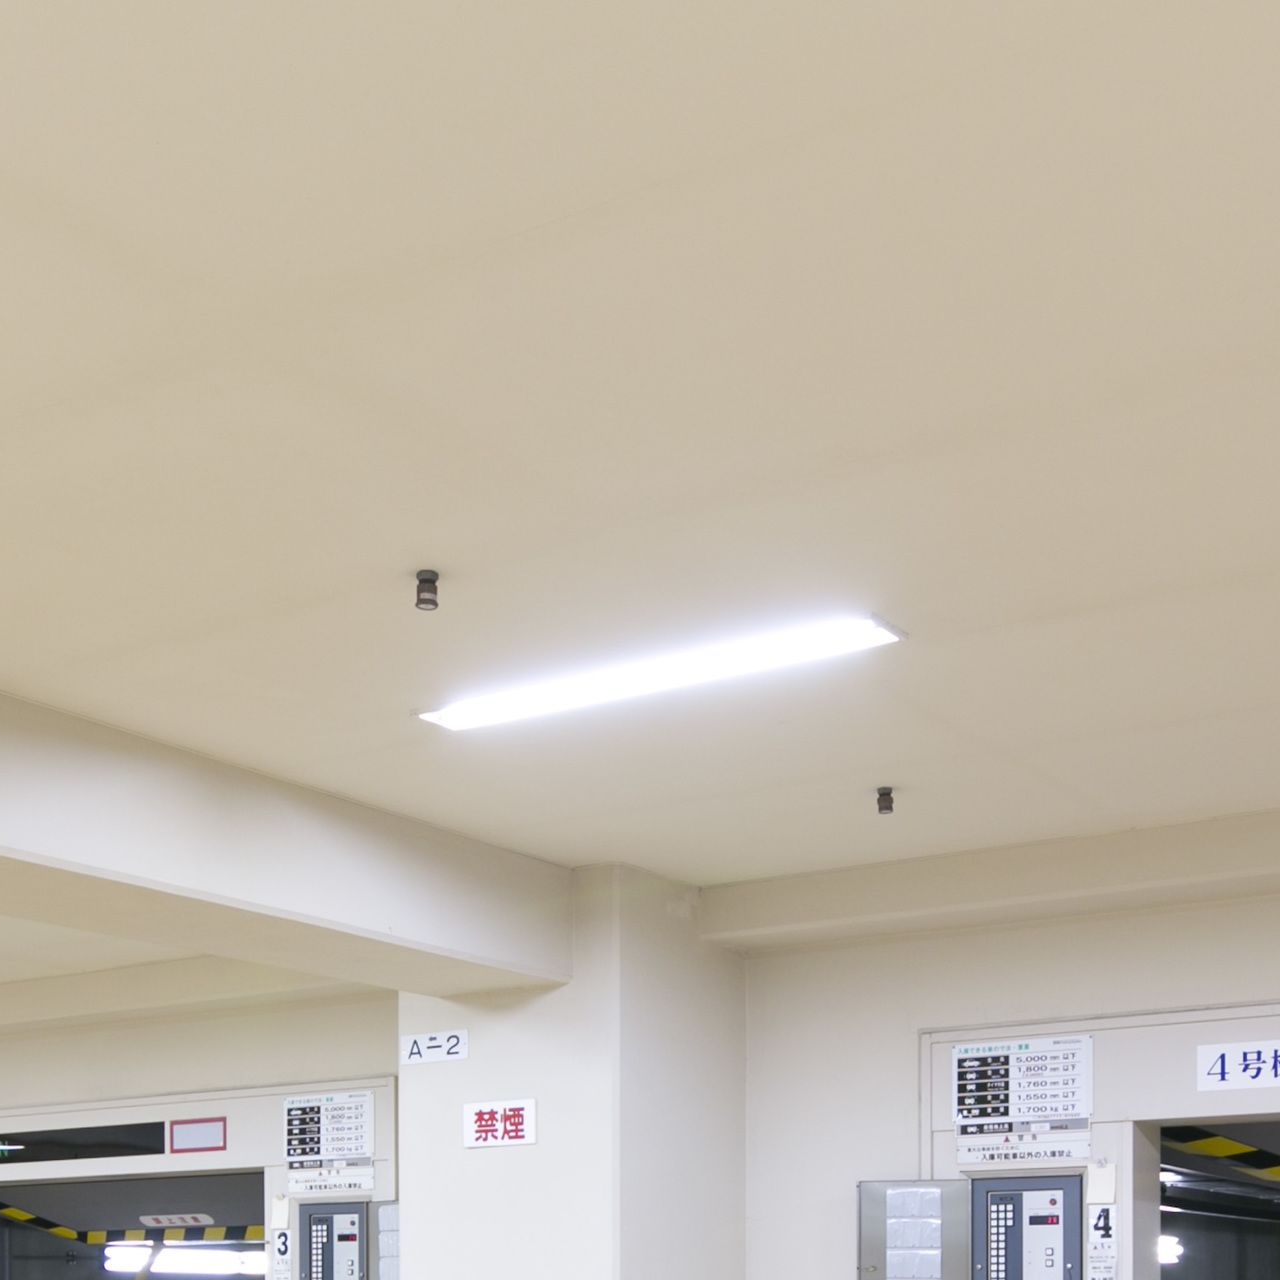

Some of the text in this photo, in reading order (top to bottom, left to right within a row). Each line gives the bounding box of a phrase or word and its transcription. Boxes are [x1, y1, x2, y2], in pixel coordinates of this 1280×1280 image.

[475, 1107, 525, 1141] 禁煙
[1093, 1208, 1112, 1238] 4
[277, 1232, 288, 1256] 3
